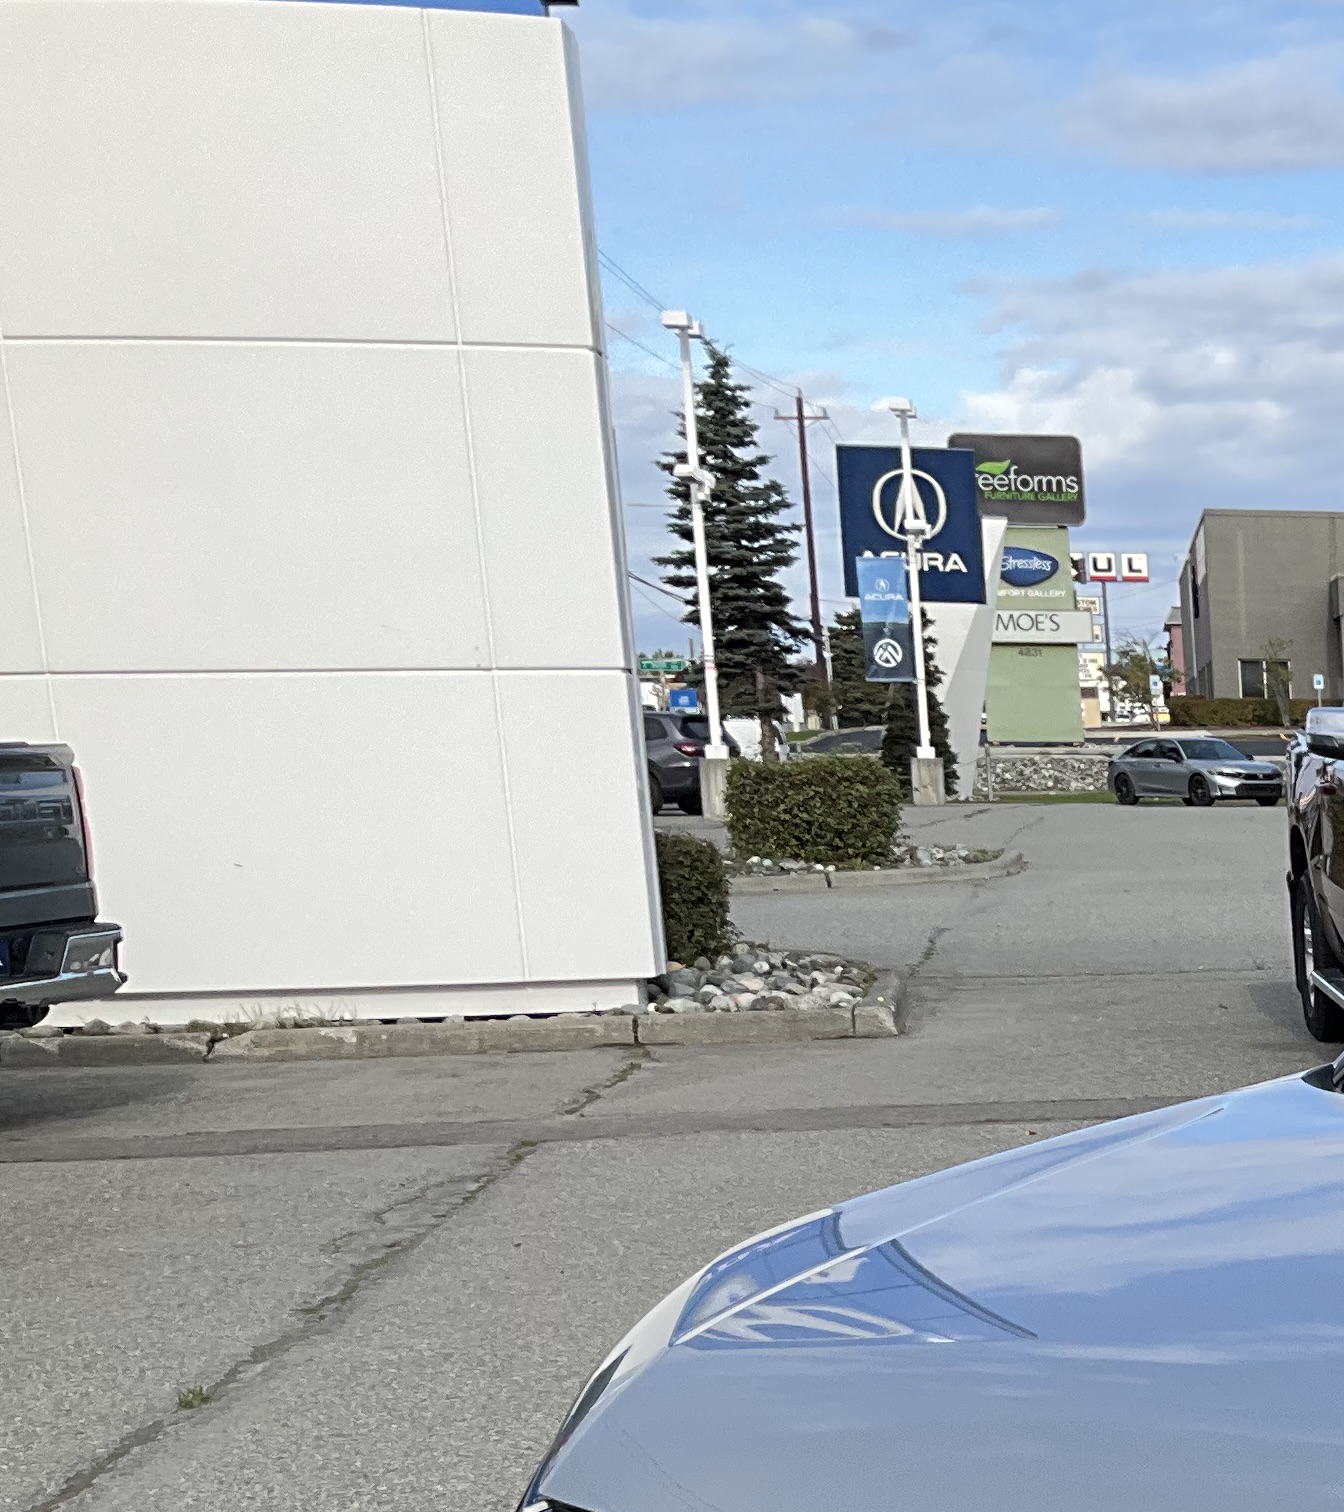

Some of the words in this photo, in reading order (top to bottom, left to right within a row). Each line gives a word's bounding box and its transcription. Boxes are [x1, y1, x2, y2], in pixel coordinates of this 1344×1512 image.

[976, 465, 1079, 493] eeforms
[1037, 491, 1079, 502] GALLERY
[864, 593, 904, 601] ACURA
[1027, 590, 1066, 598] GALLERY
[995, 613, 1060, 632] MOE'S
